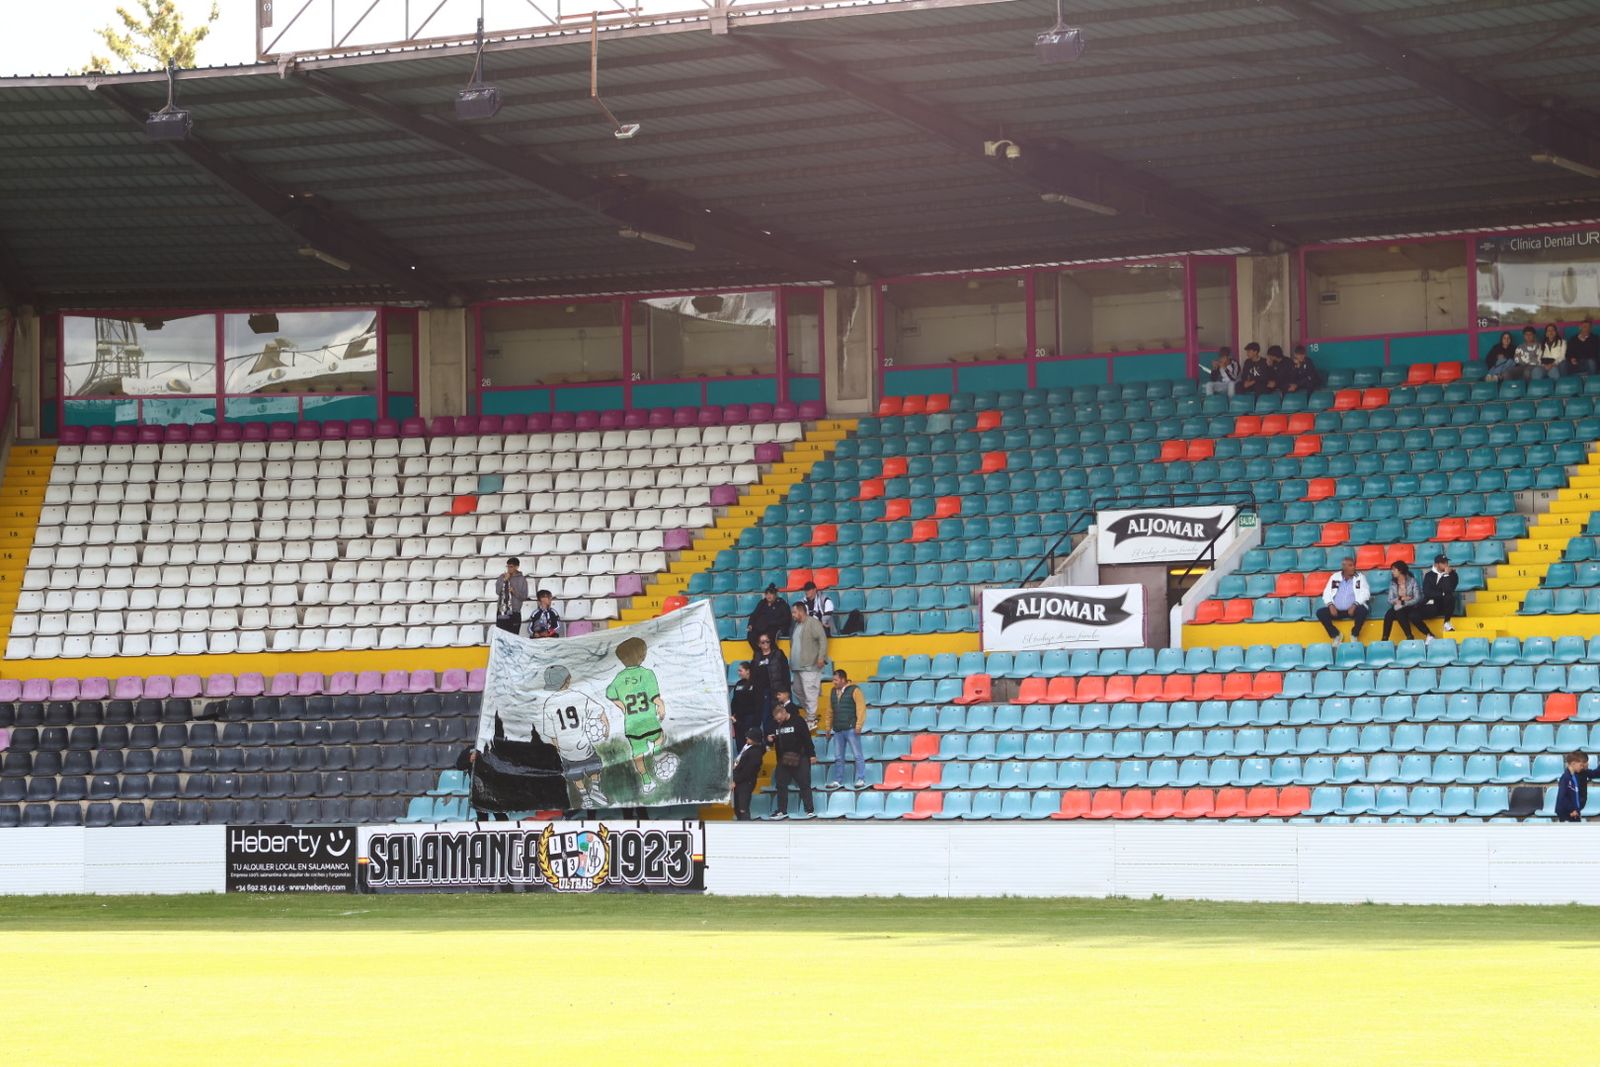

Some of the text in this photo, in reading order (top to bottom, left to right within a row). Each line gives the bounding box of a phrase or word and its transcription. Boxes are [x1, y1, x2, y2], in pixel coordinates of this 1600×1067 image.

[1510, 232, 1600, 251] Clínica Dental UR
[1478, 318, 1487, 327] 16
[1035, 348, 1046, 357] 20
[1310, 343, 1319, 352] 18
[884, 358, 893, 367] 22
[1128, 519, 1205, 538] ALJOMAR
[1016, 598, 1108, 621] ALJOMAR
[625, 691, 649, 715] 23
[556, 705, 580, 731] 19
[232, 830, 321, 857] Heberty
[368, 832, 544, 885] SALAMANCA
[608, 831, 693, 885] 1923
[554, 859, 575, 873] 2 3
[288, 883, 346, 892] www.heberty.com
[559, 878, 593, 889] ULTRAS
